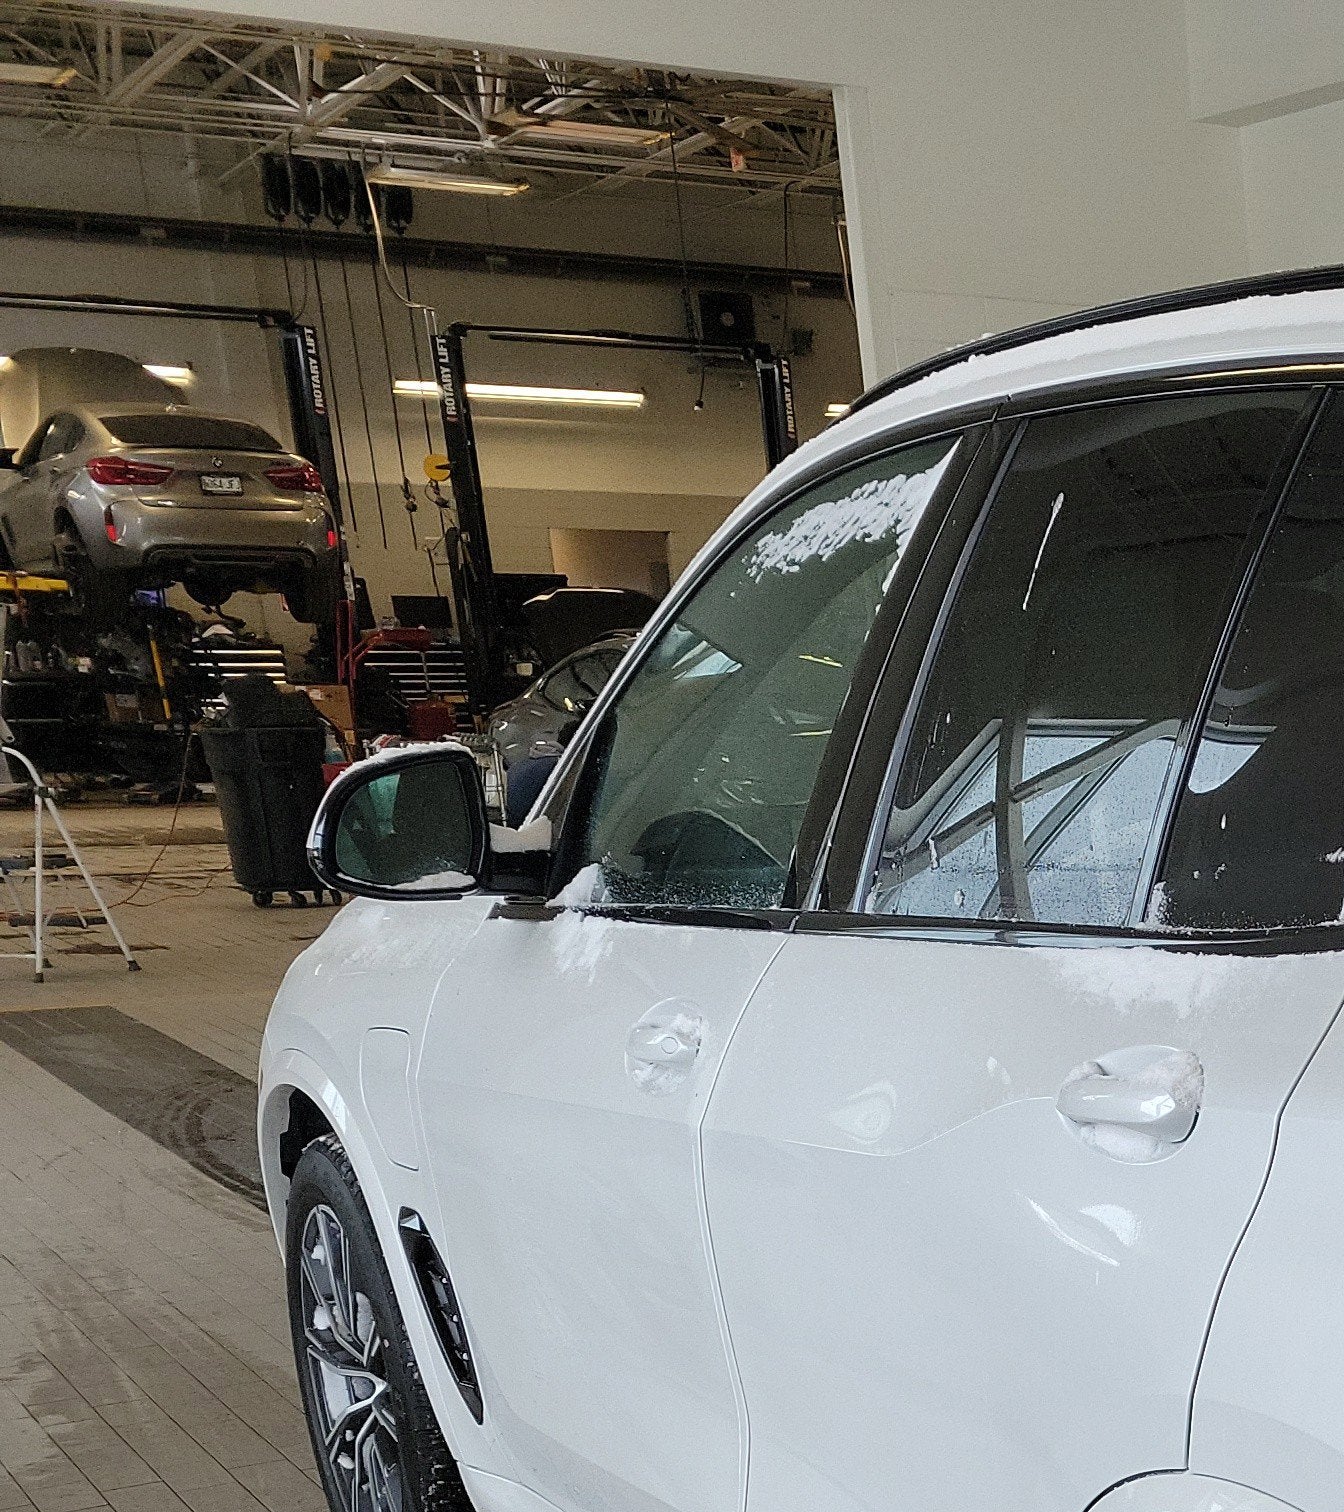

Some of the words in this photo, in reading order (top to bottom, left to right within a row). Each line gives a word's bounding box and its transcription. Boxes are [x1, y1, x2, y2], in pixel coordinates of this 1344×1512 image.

[304, 327, 316, 354] LIFT
[436, 337, 449, 362] LIFT
[309, 357, 323, 406] ROTARY
[781, 359, 789, 383] LIFT
[440, 366, 457, 414] ROTARY
[784, 387, 795, 431] ROTARY
